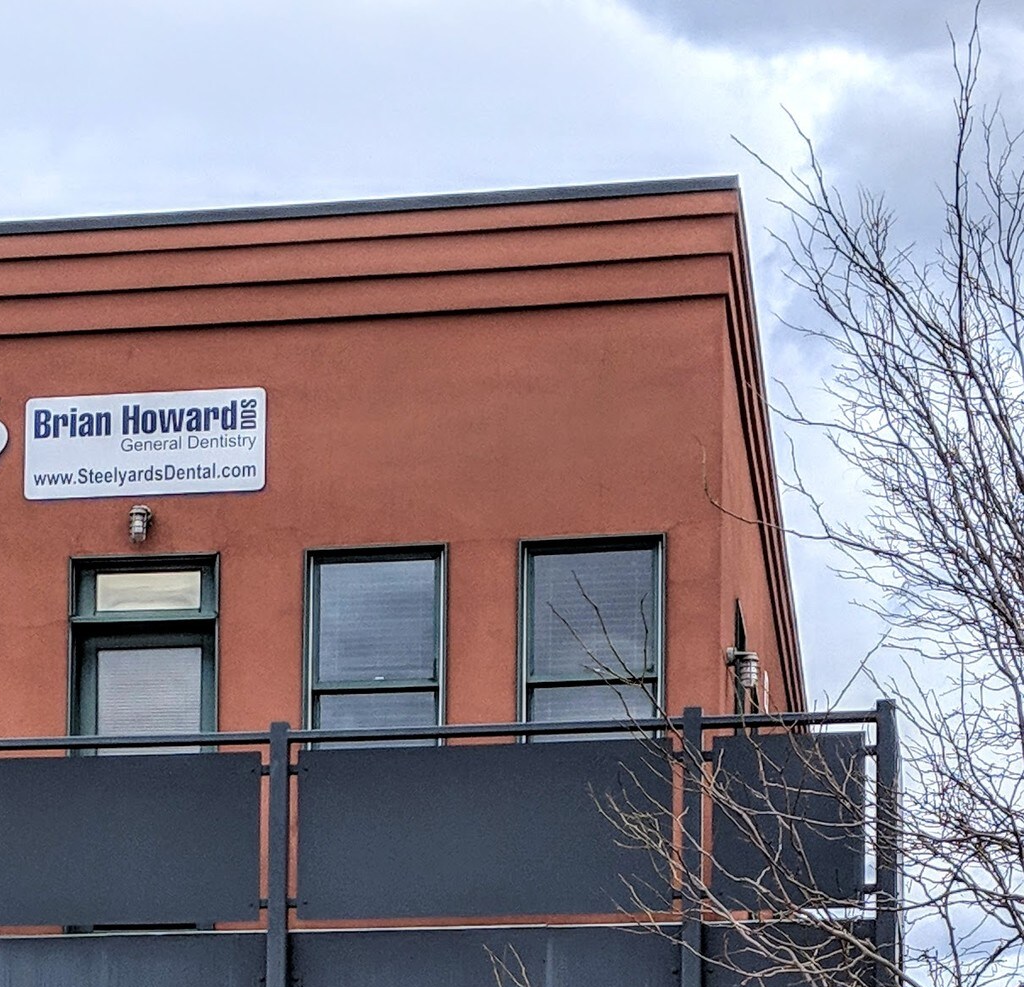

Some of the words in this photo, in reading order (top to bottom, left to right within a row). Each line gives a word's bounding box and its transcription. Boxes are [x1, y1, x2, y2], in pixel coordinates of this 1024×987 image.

[33, 407, 112, 439] Brian
[122, 400, 238, 435] Howard
[240, 398, 258, 429] DDS
[121, 437, 182, 452] General
[187, 435, 257, 450] Dentistry
[33, 463, 257, 487] www.SteelyardsDental.com
